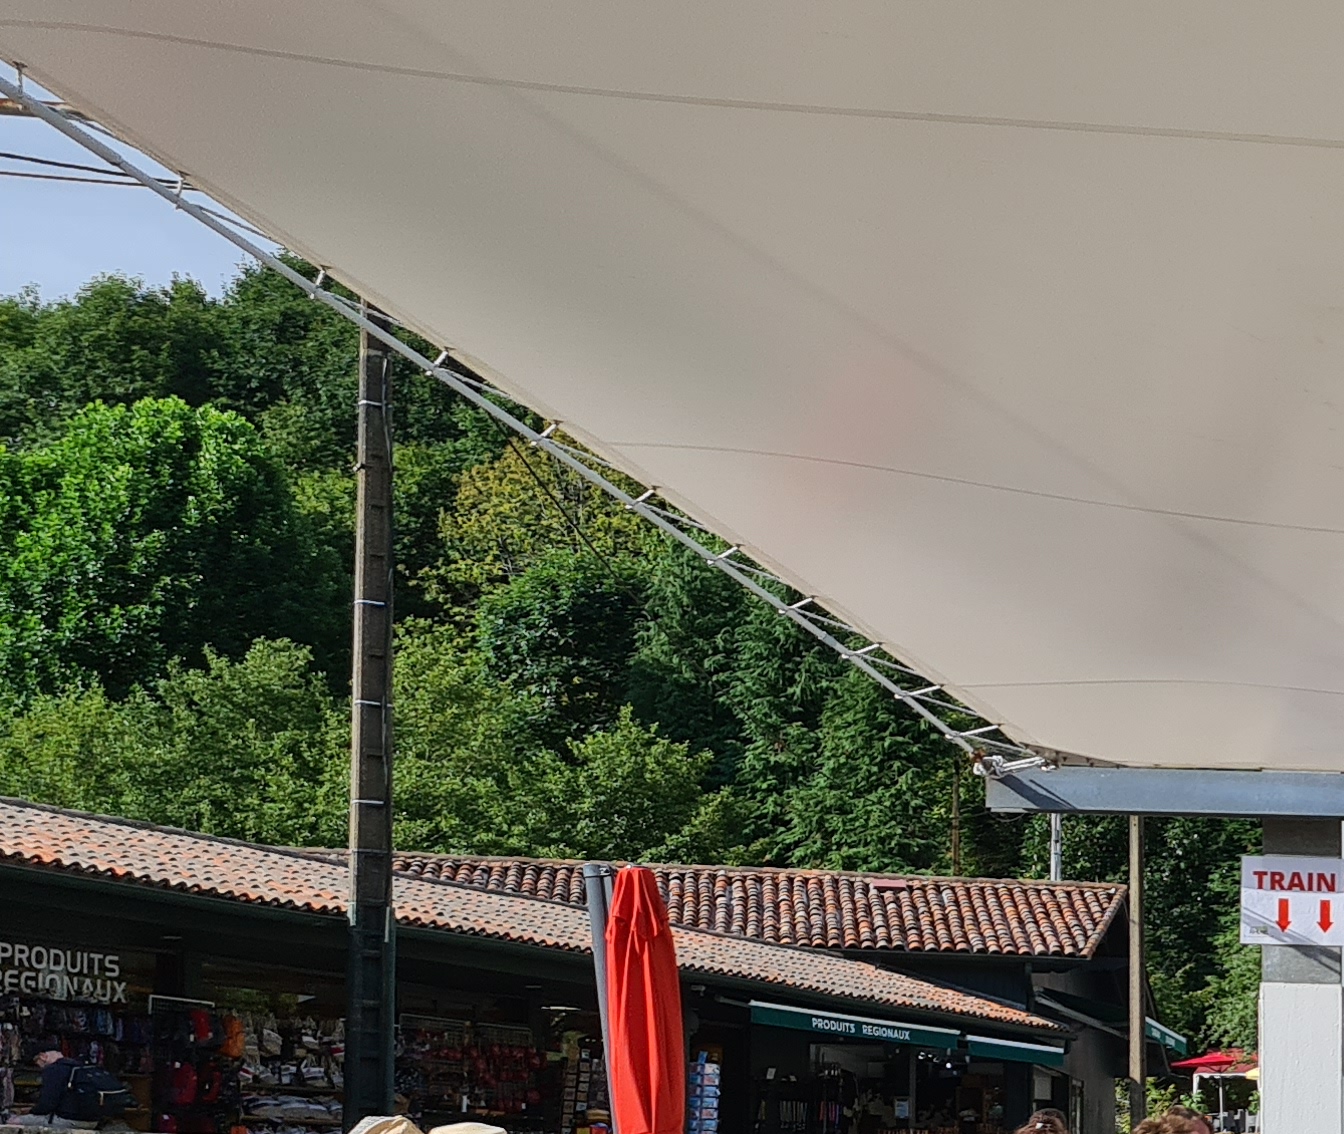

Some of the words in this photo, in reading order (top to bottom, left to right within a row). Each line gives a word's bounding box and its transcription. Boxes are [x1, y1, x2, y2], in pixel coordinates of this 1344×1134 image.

[1253, 871, 1336, 893] TRAIN
[0, 941, 120, 977] PRODUITS
[0, 969, 127, 1004] EGIONAUX
[811, 1017, 856, 1034] PRODUITS
[862, 1024, 911, 1041] REGIONAUX
